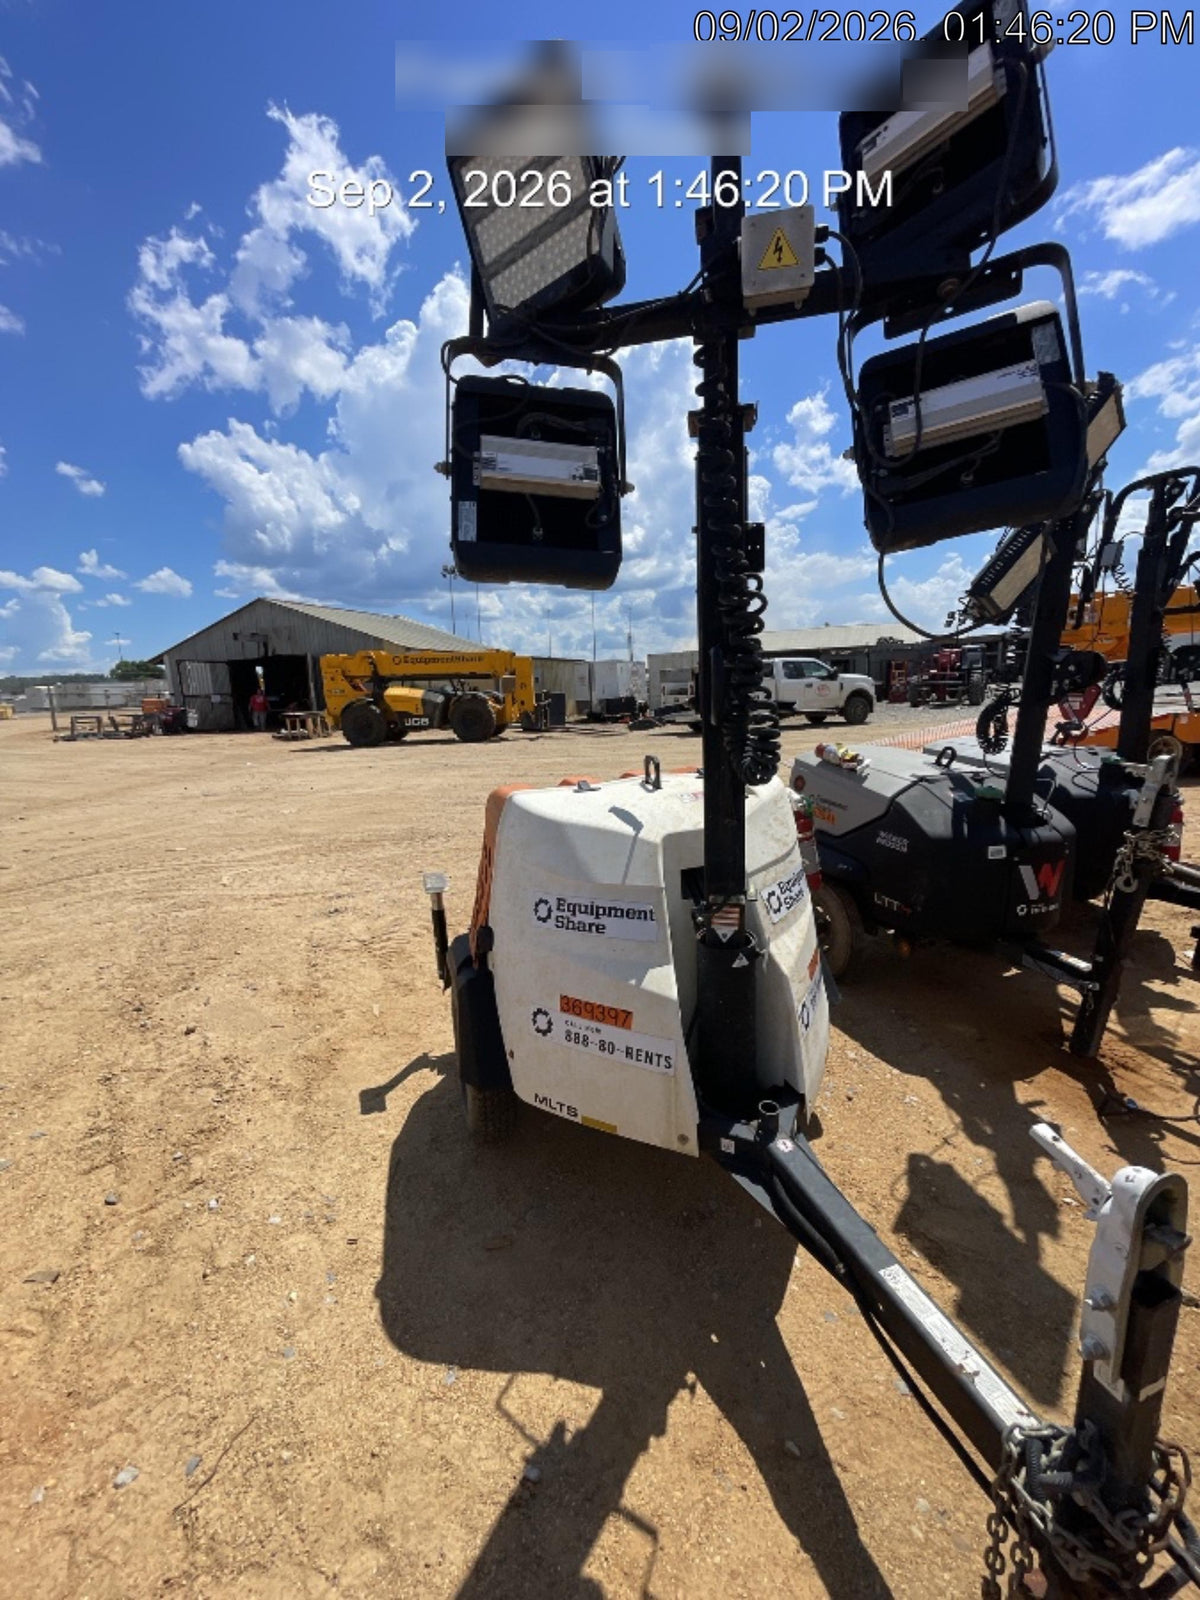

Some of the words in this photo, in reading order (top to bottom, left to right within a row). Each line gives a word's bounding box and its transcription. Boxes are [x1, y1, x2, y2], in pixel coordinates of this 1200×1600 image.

[556, 898, 656, 923] Equipment
[555, 915, 606, 934] Share
[560, 995, 633, 1029] 369397
